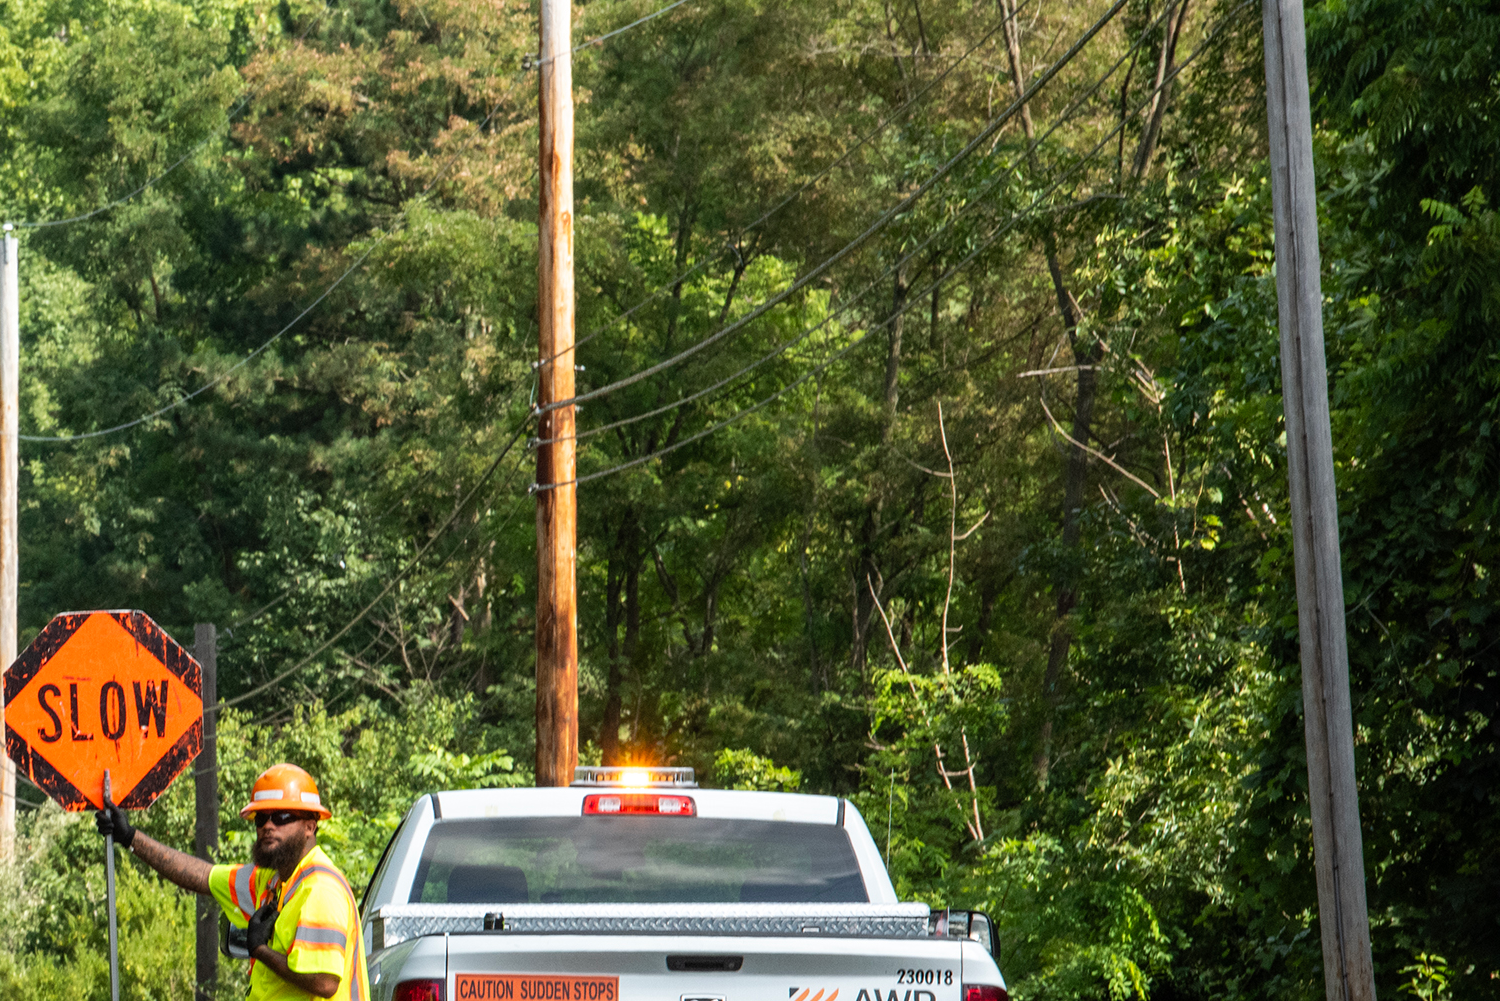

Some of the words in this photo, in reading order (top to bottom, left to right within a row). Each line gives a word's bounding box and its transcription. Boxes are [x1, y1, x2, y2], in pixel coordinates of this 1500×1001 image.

[37, 679, 169, 744] SLOW
[896, 968, 953, 985] 230018
[460, 979, 514, 999] CAUTION
[520, 980, 570, 1000] SUDDEN
[573, 981, 614, 1001] STOPS
